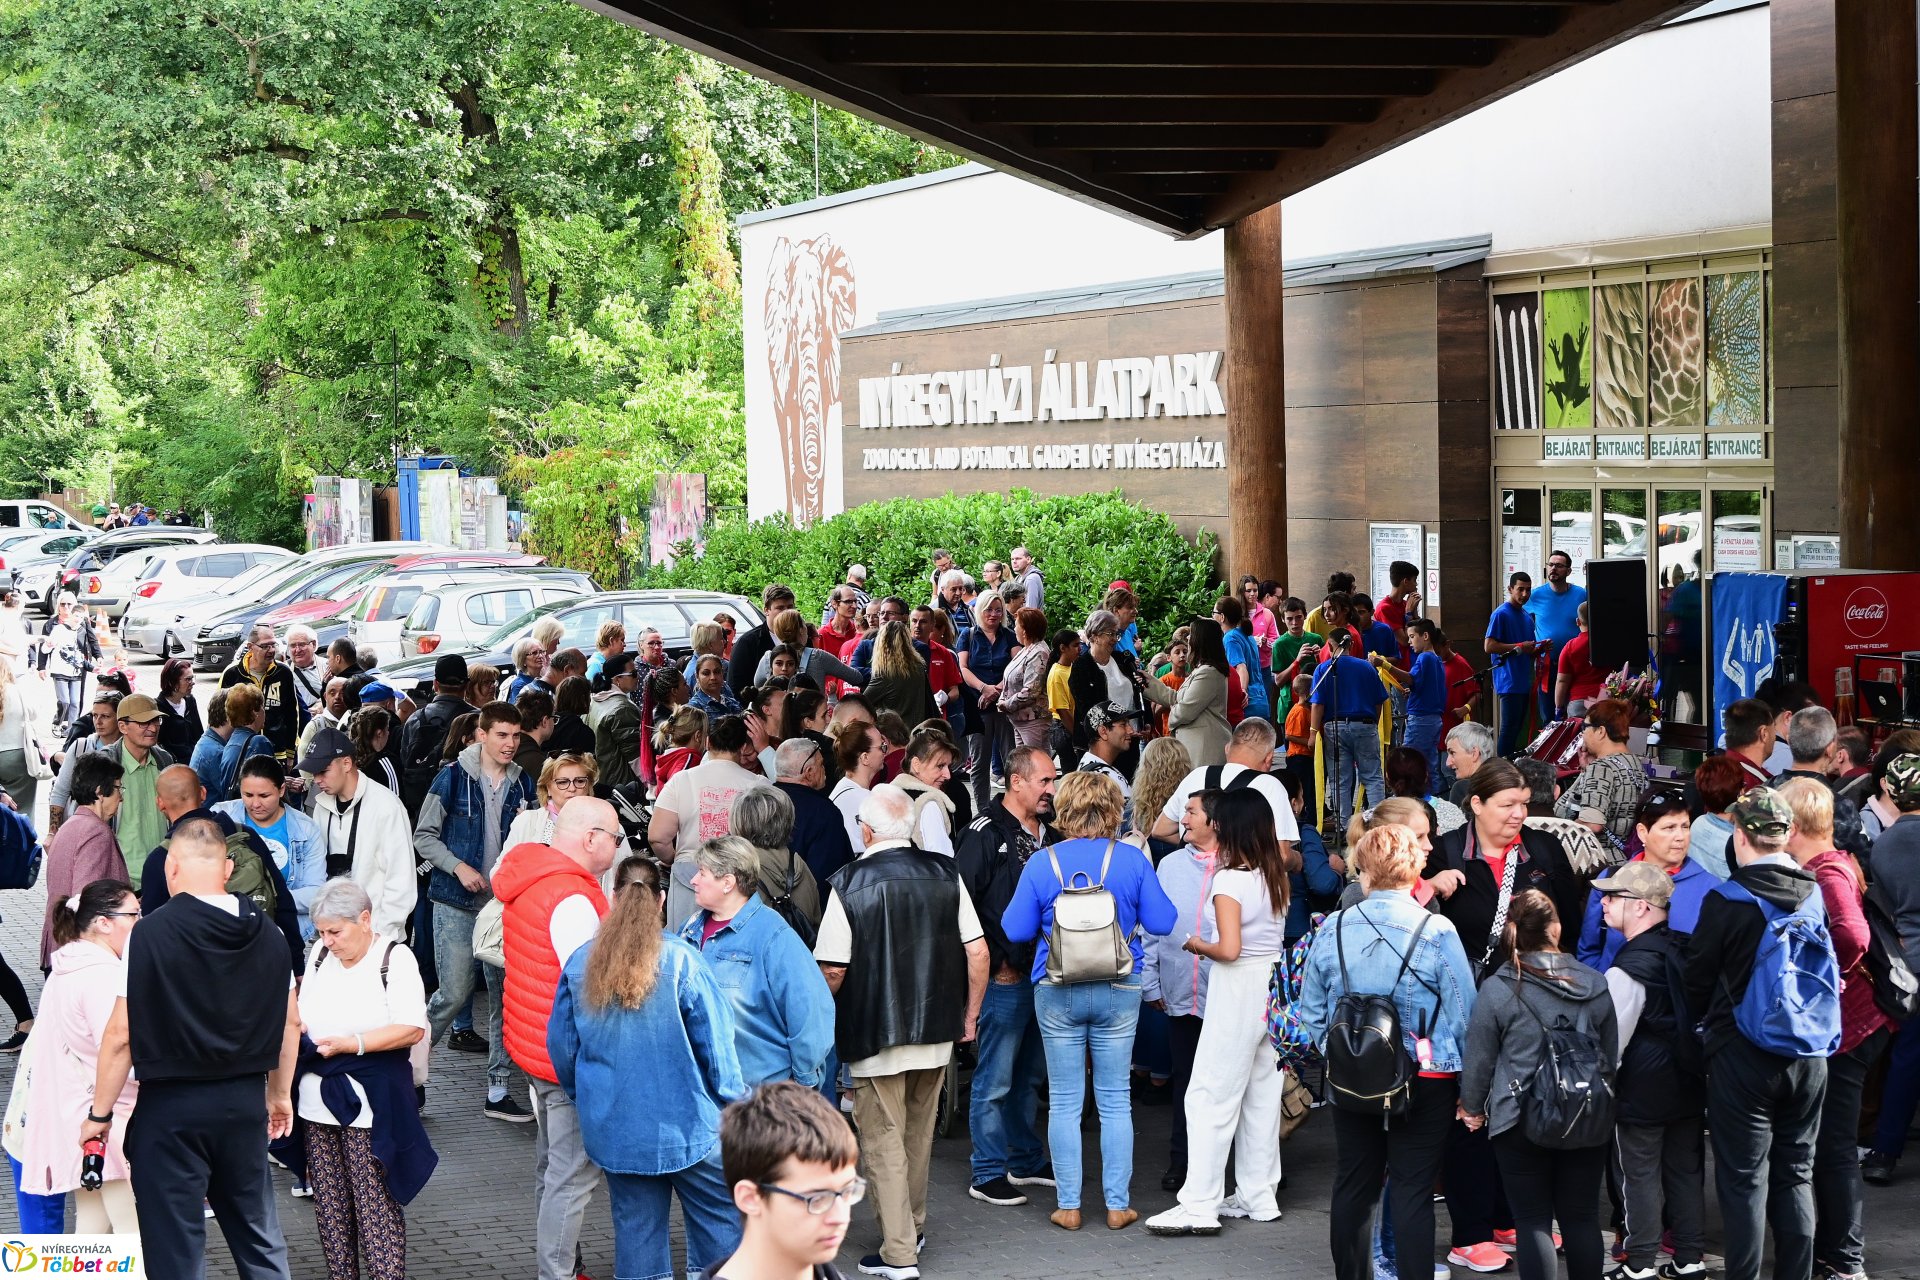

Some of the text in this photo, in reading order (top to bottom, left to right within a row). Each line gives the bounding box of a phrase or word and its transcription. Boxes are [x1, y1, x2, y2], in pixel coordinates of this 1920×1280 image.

[858, 349, 1226, 429] NYÍREGYHÁZI ÁLLATPARK
[862, 436, 1227, 470] ZOOLOGICAL AND BOTANICAL GARDEN OF NYÍREGYHÁZA
[1546, 438, 1591, 456] BEJÁRAT
[1597, 441, 1645, 456] ENTRANCE
[1651, 437, 1702, 456] BEJÁRAT
[1707, 439, 1762, 456] ENTRANCE
[1778, 545, 1789, 553] ATM
[1846, 604, 1886, 620] Coca-Cola
[703, 791, 720, 801] LATE
